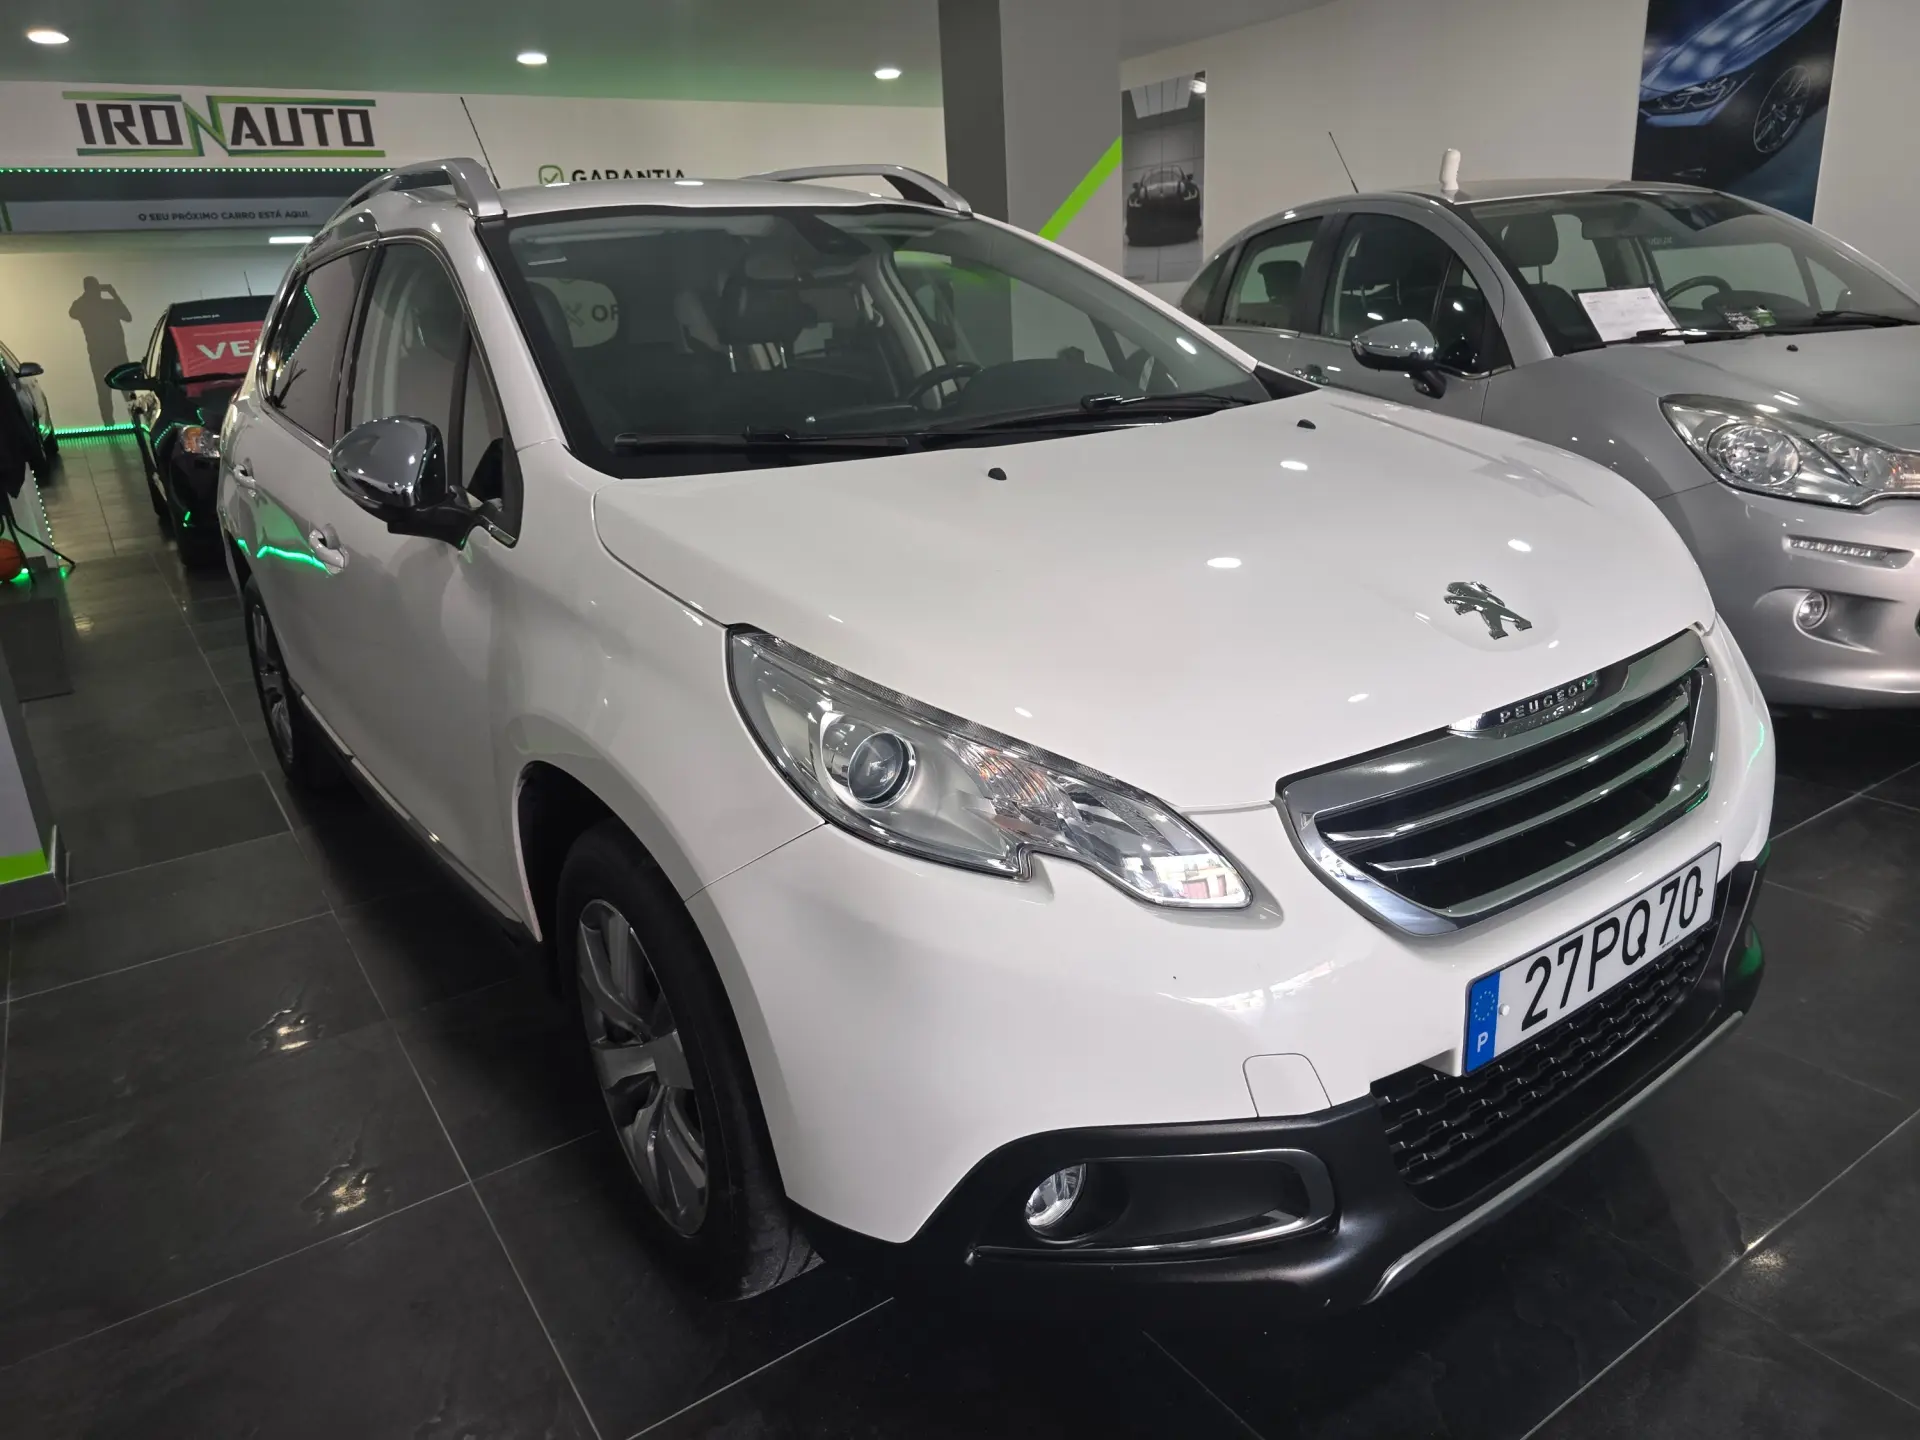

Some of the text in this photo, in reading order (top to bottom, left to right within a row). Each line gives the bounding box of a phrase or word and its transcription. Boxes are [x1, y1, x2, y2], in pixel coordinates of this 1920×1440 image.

[138, 212, 147, 222] O
[149, 212, 169, 222] SEU
[172, 210, 219, 222] PRÓXIMO
[221, 211, 256, 220] CARRO
[258, 209, 282, 220] ESTÁ
[196, 340, 258, 360] VE
[1500, 678, 1589, 723] PEUGEOT
[1476, 1031, 1489, 1053] P
